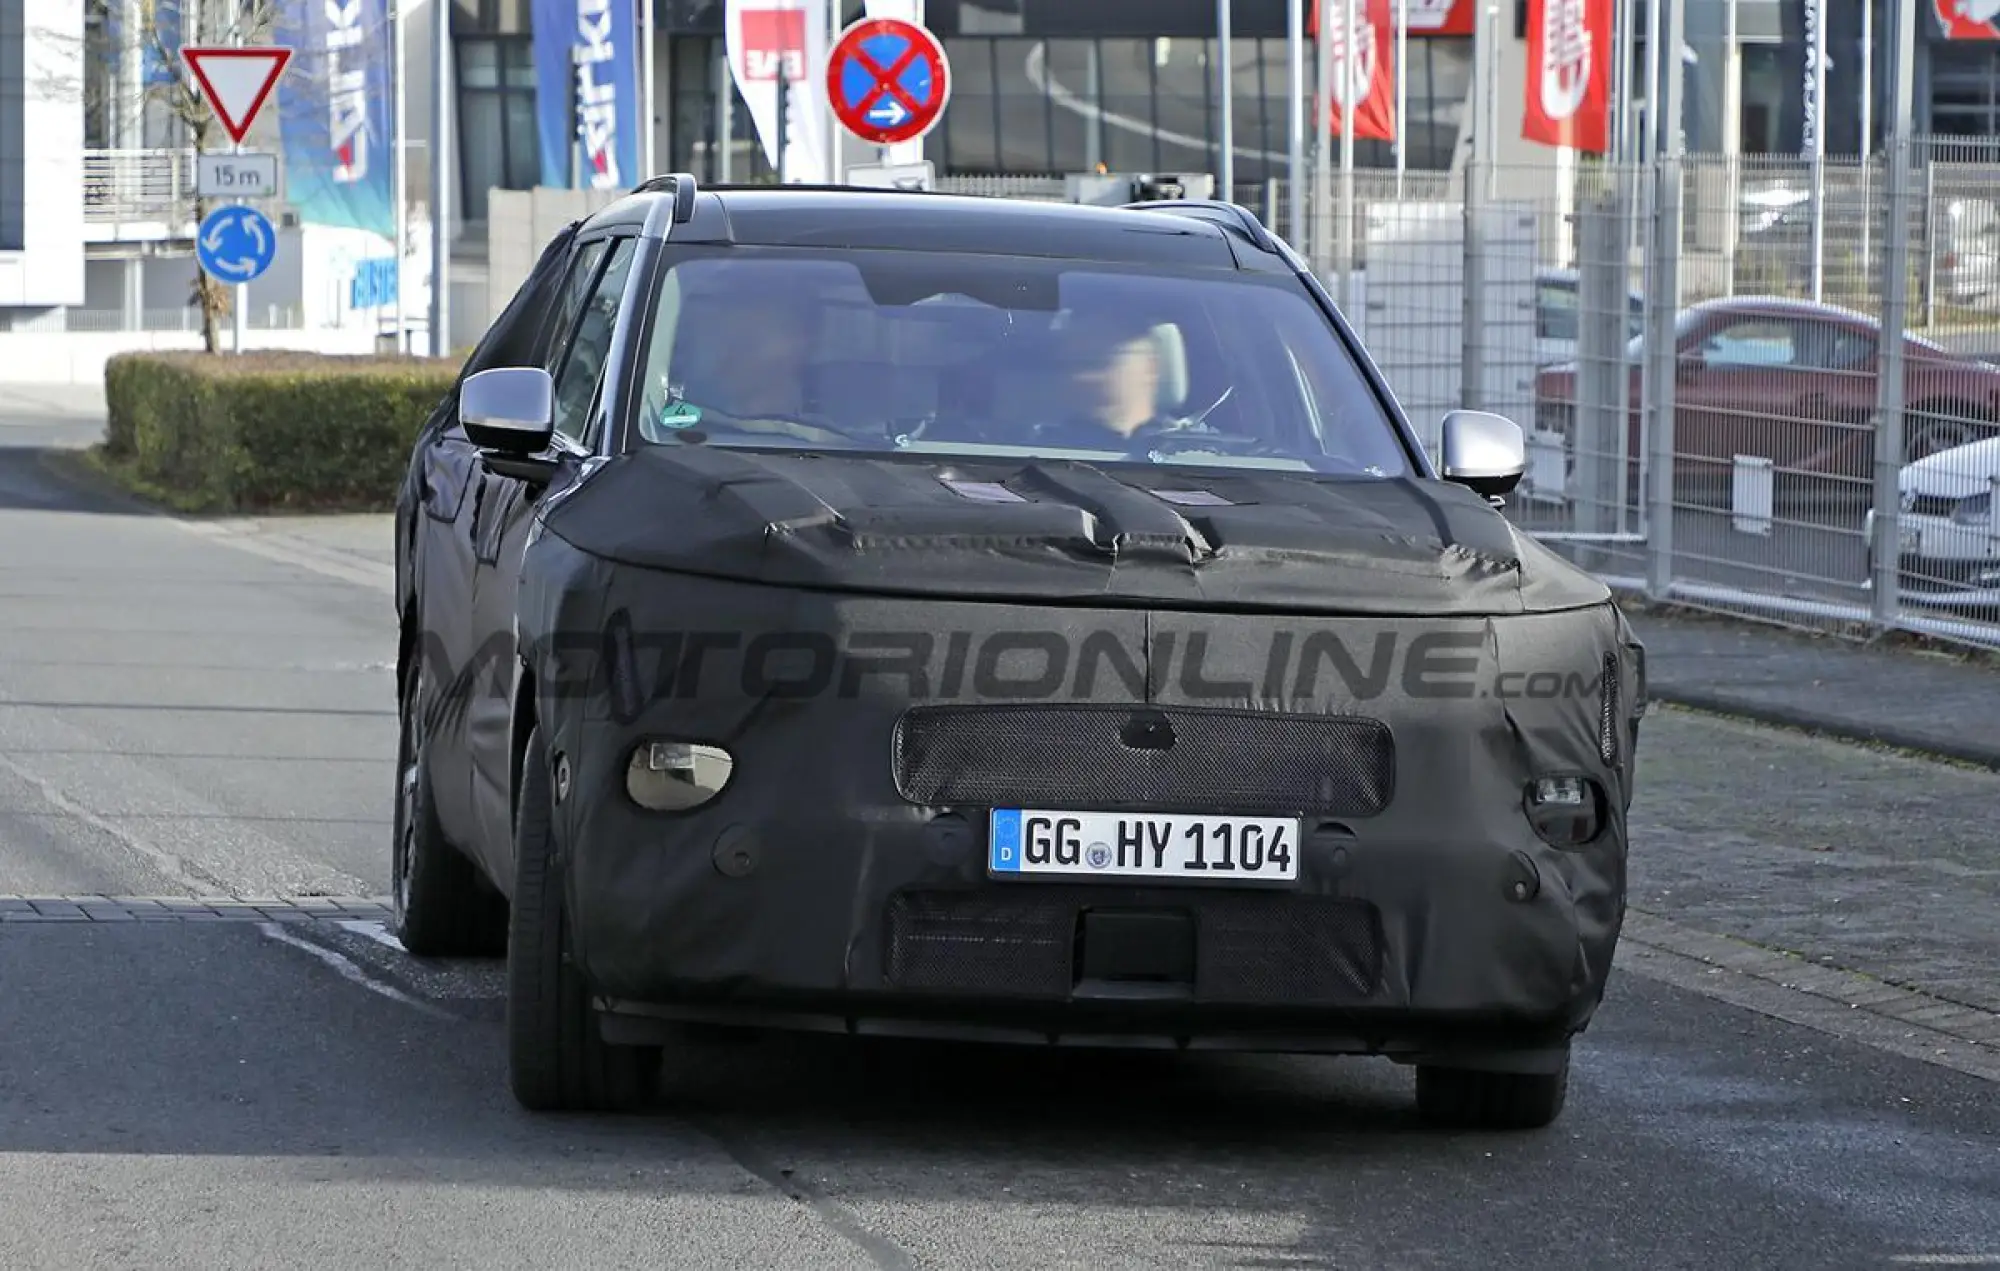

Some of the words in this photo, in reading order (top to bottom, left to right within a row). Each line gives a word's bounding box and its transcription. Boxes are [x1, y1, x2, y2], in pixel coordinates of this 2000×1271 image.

[214, 164, 234, 187] 15
[239, 169, 260, 187] m
[1001, 847, 1012, 862] D
[1025, 817, 1081, 866] GG
[1117, 820, 1173, 869] HY
[1184, 822, 1291, 872] 1104
